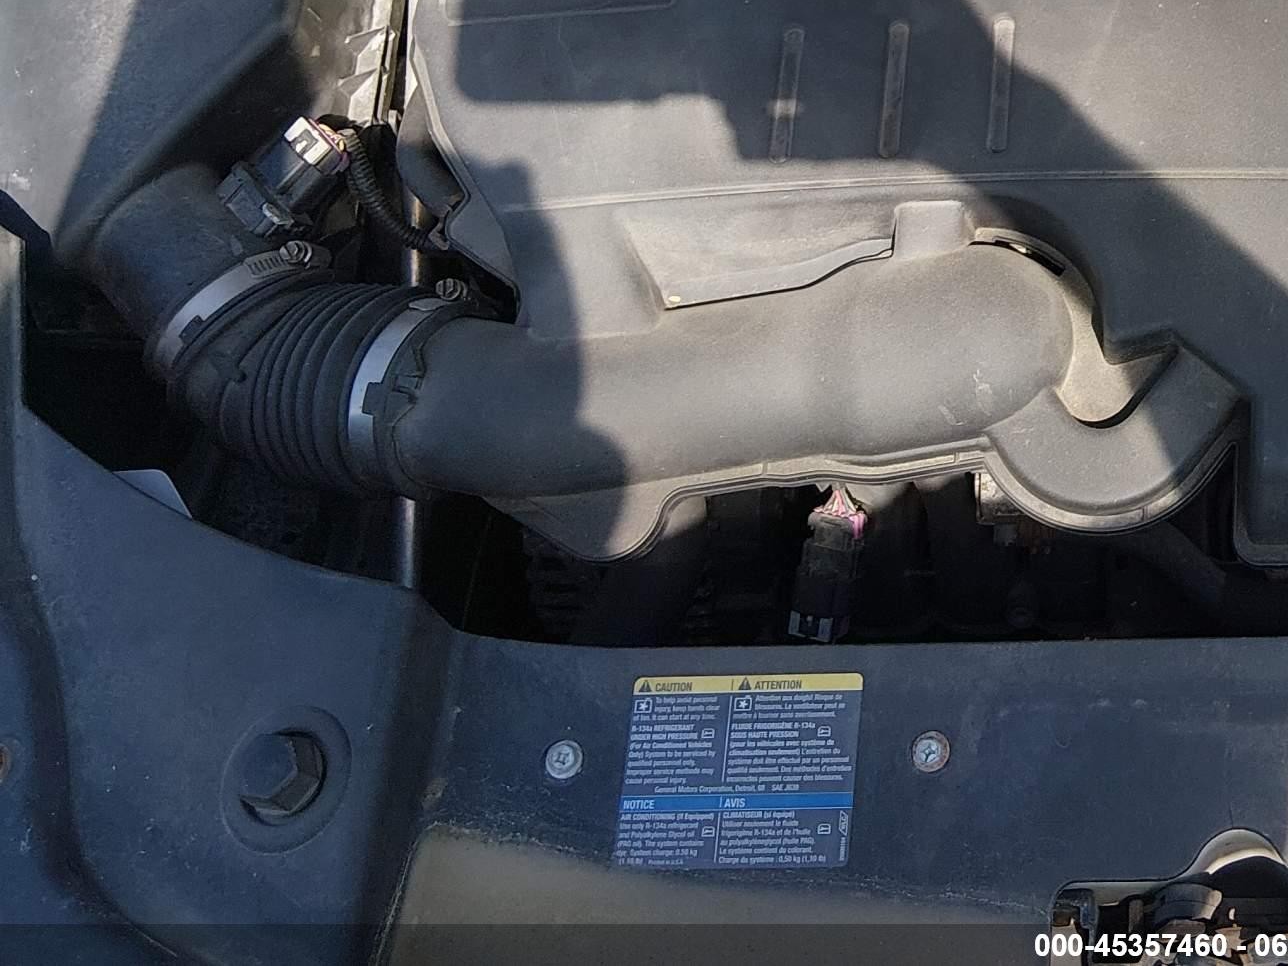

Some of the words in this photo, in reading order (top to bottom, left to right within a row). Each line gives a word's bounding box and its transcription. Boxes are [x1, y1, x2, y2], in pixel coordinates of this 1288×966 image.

[655, 682, 693, 692] CAUTION
[754, 680, 802, 690] ATTENTION
[623, 799, 655, 809] NOTICE
[724, 798, 746, 808] AVIS
